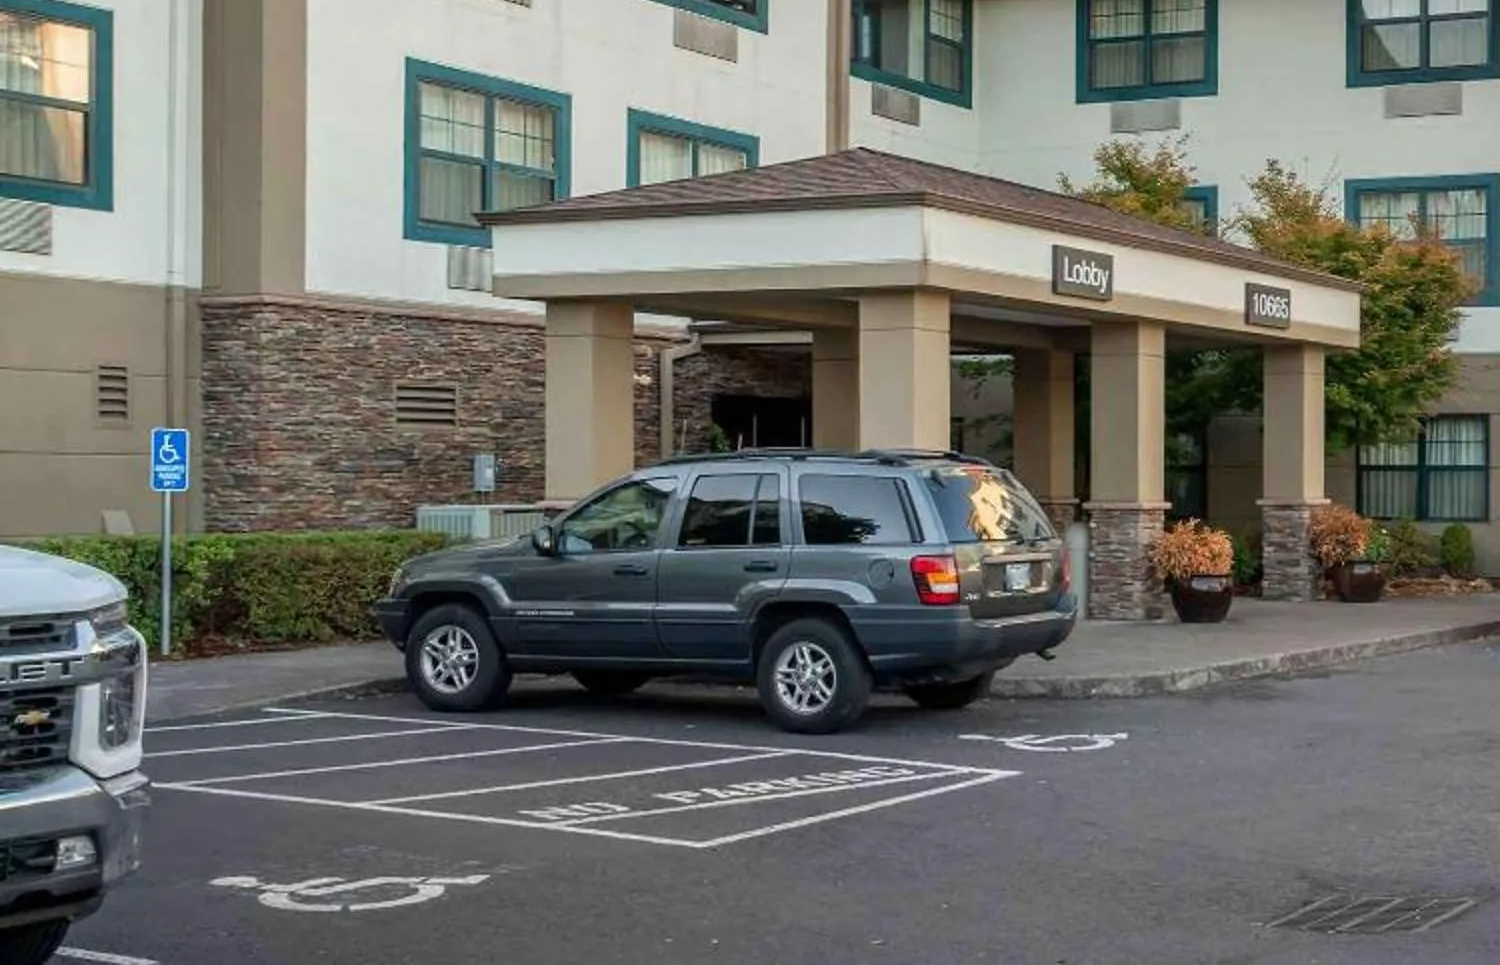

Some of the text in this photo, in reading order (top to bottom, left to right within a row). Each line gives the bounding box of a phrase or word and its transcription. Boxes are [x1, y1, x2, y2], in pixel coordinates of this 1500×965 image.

[1063, 255, 1109, 294] Lobby
[517, 766, 915, 821] NO PARKING
